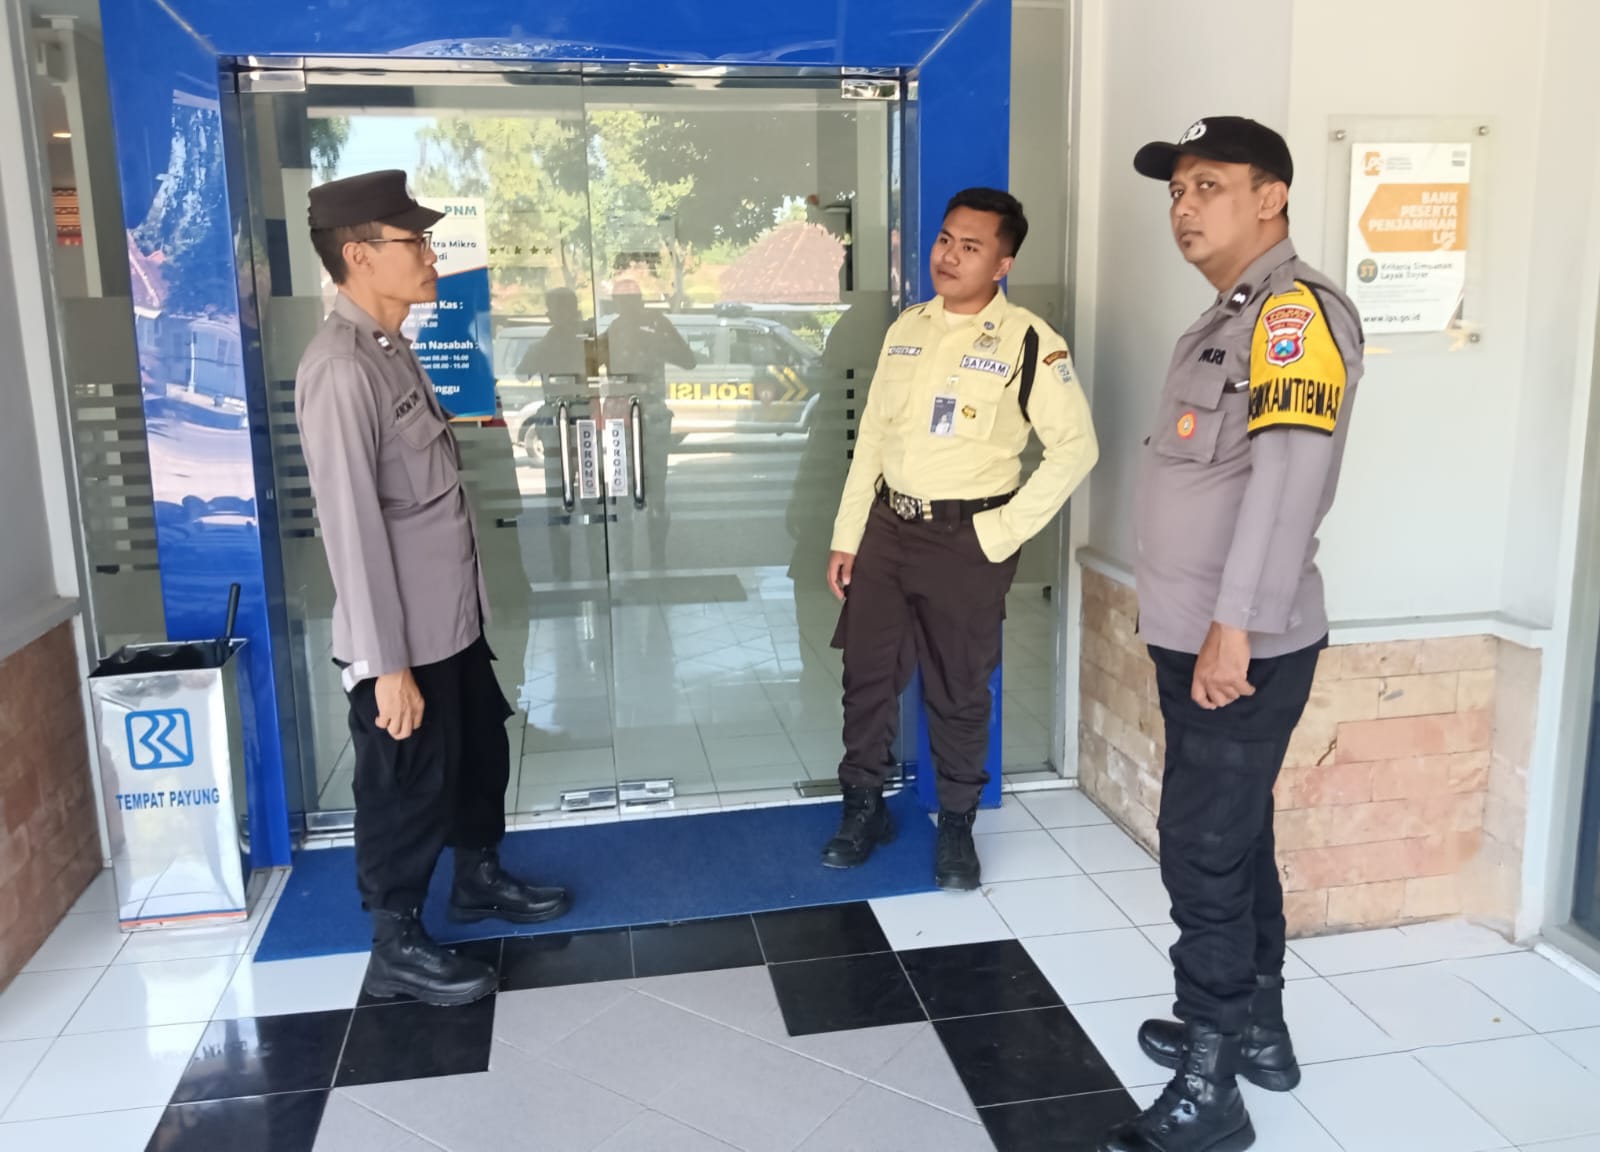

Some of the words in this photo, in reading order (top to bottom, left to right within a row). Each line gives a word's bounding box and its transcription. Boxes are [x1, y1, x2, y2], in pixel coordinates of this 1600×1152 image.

[1421, 191, 1458, 204] BANK
[444, 205, 477, 216] PNM
[1400, 204, 1457, 217] PESERTA
[1368, 218, 1457, 232] PENJAMINAN
[449, 240, 477, 248] Mikro
[439, 301, 458, 310] Kas
[428, 340, 474, 350] Nasabah
[963, 356, 1008, 376] SATPAM
[583, 430, 594, 488] DORONG
[611, 430, 622, 486] DORONG
[115, 791, 165, 811] TEMPAT
[170, 787, 220, 807] PAYUNG
